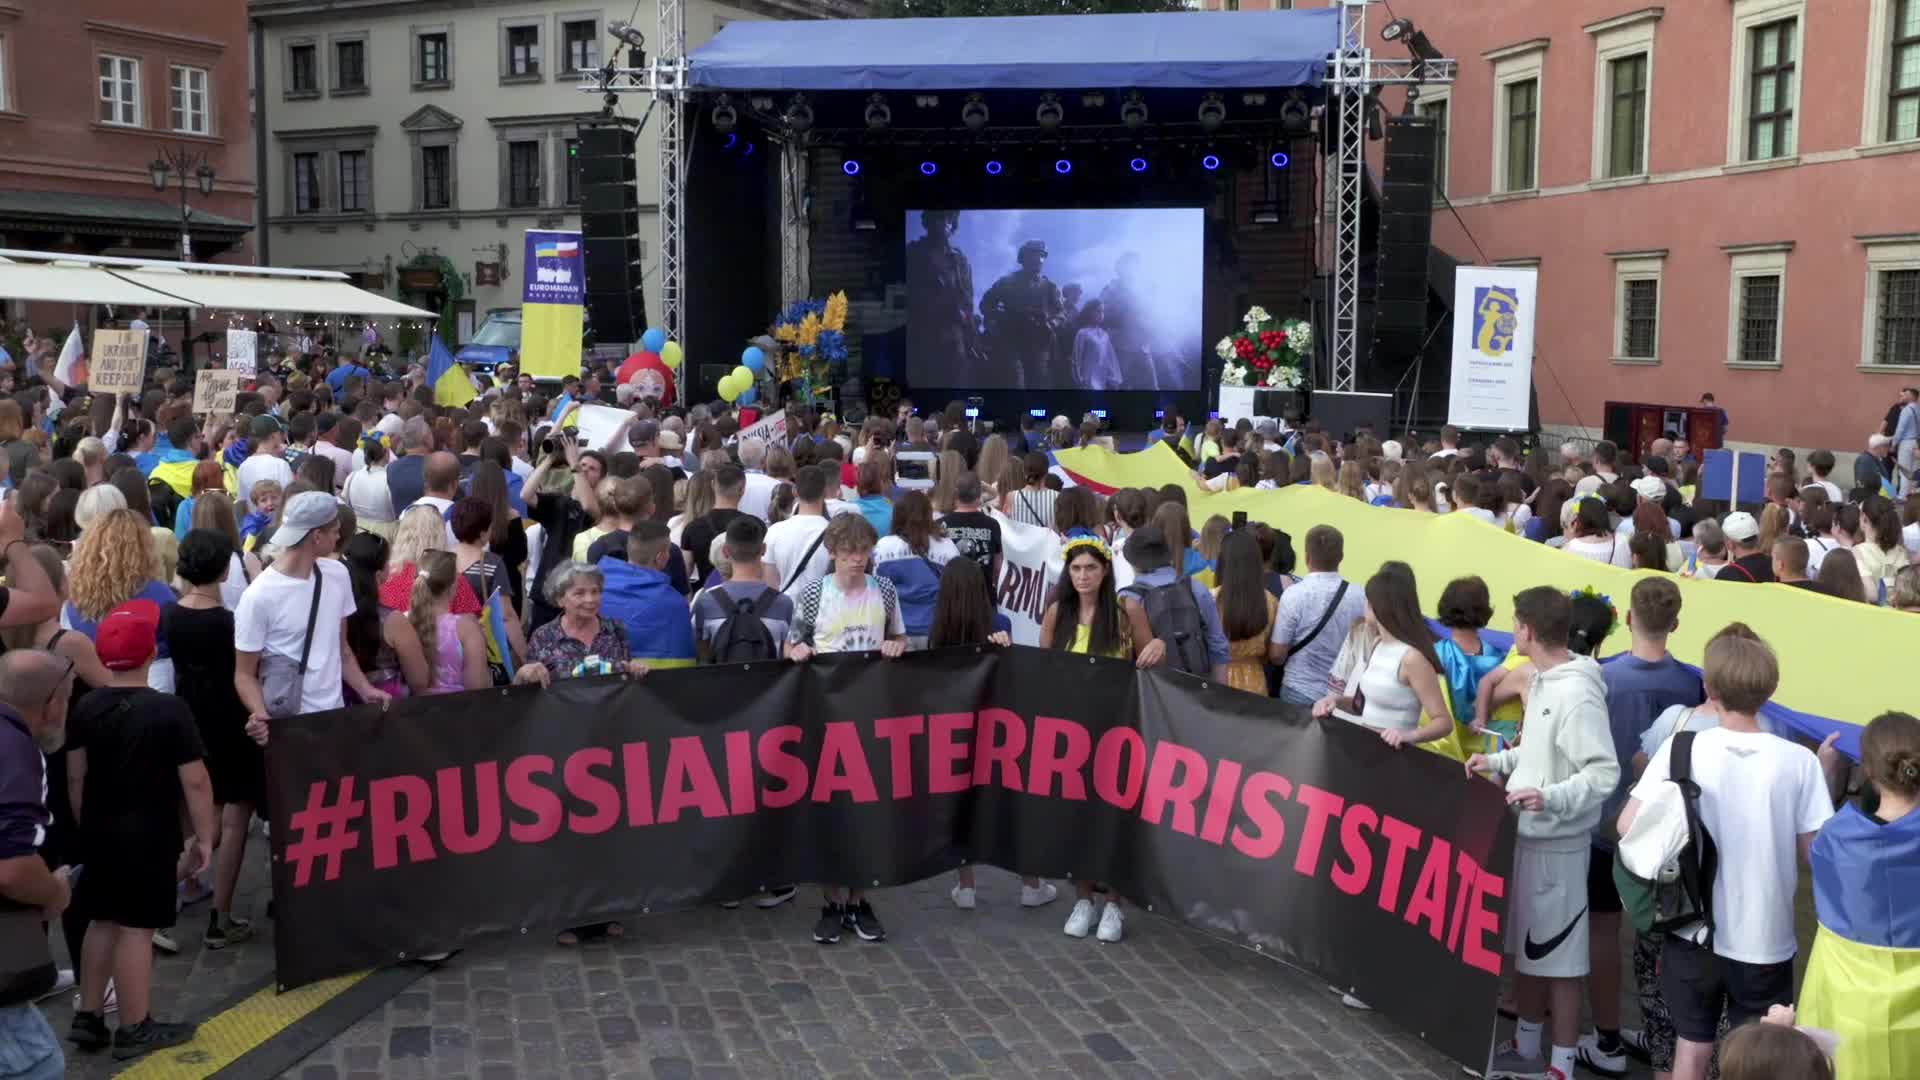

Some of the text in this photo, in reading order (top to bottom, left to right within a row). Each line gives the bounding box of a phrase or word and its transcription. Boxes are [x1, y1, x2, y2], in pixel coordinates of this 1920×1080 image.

[529, 283, 579, 292] EUROMAIDAN
[95, 372, 121, 386] KEEP
[286, 708, 1505, 977] #RUSSIAISATERRORISTSTATE
